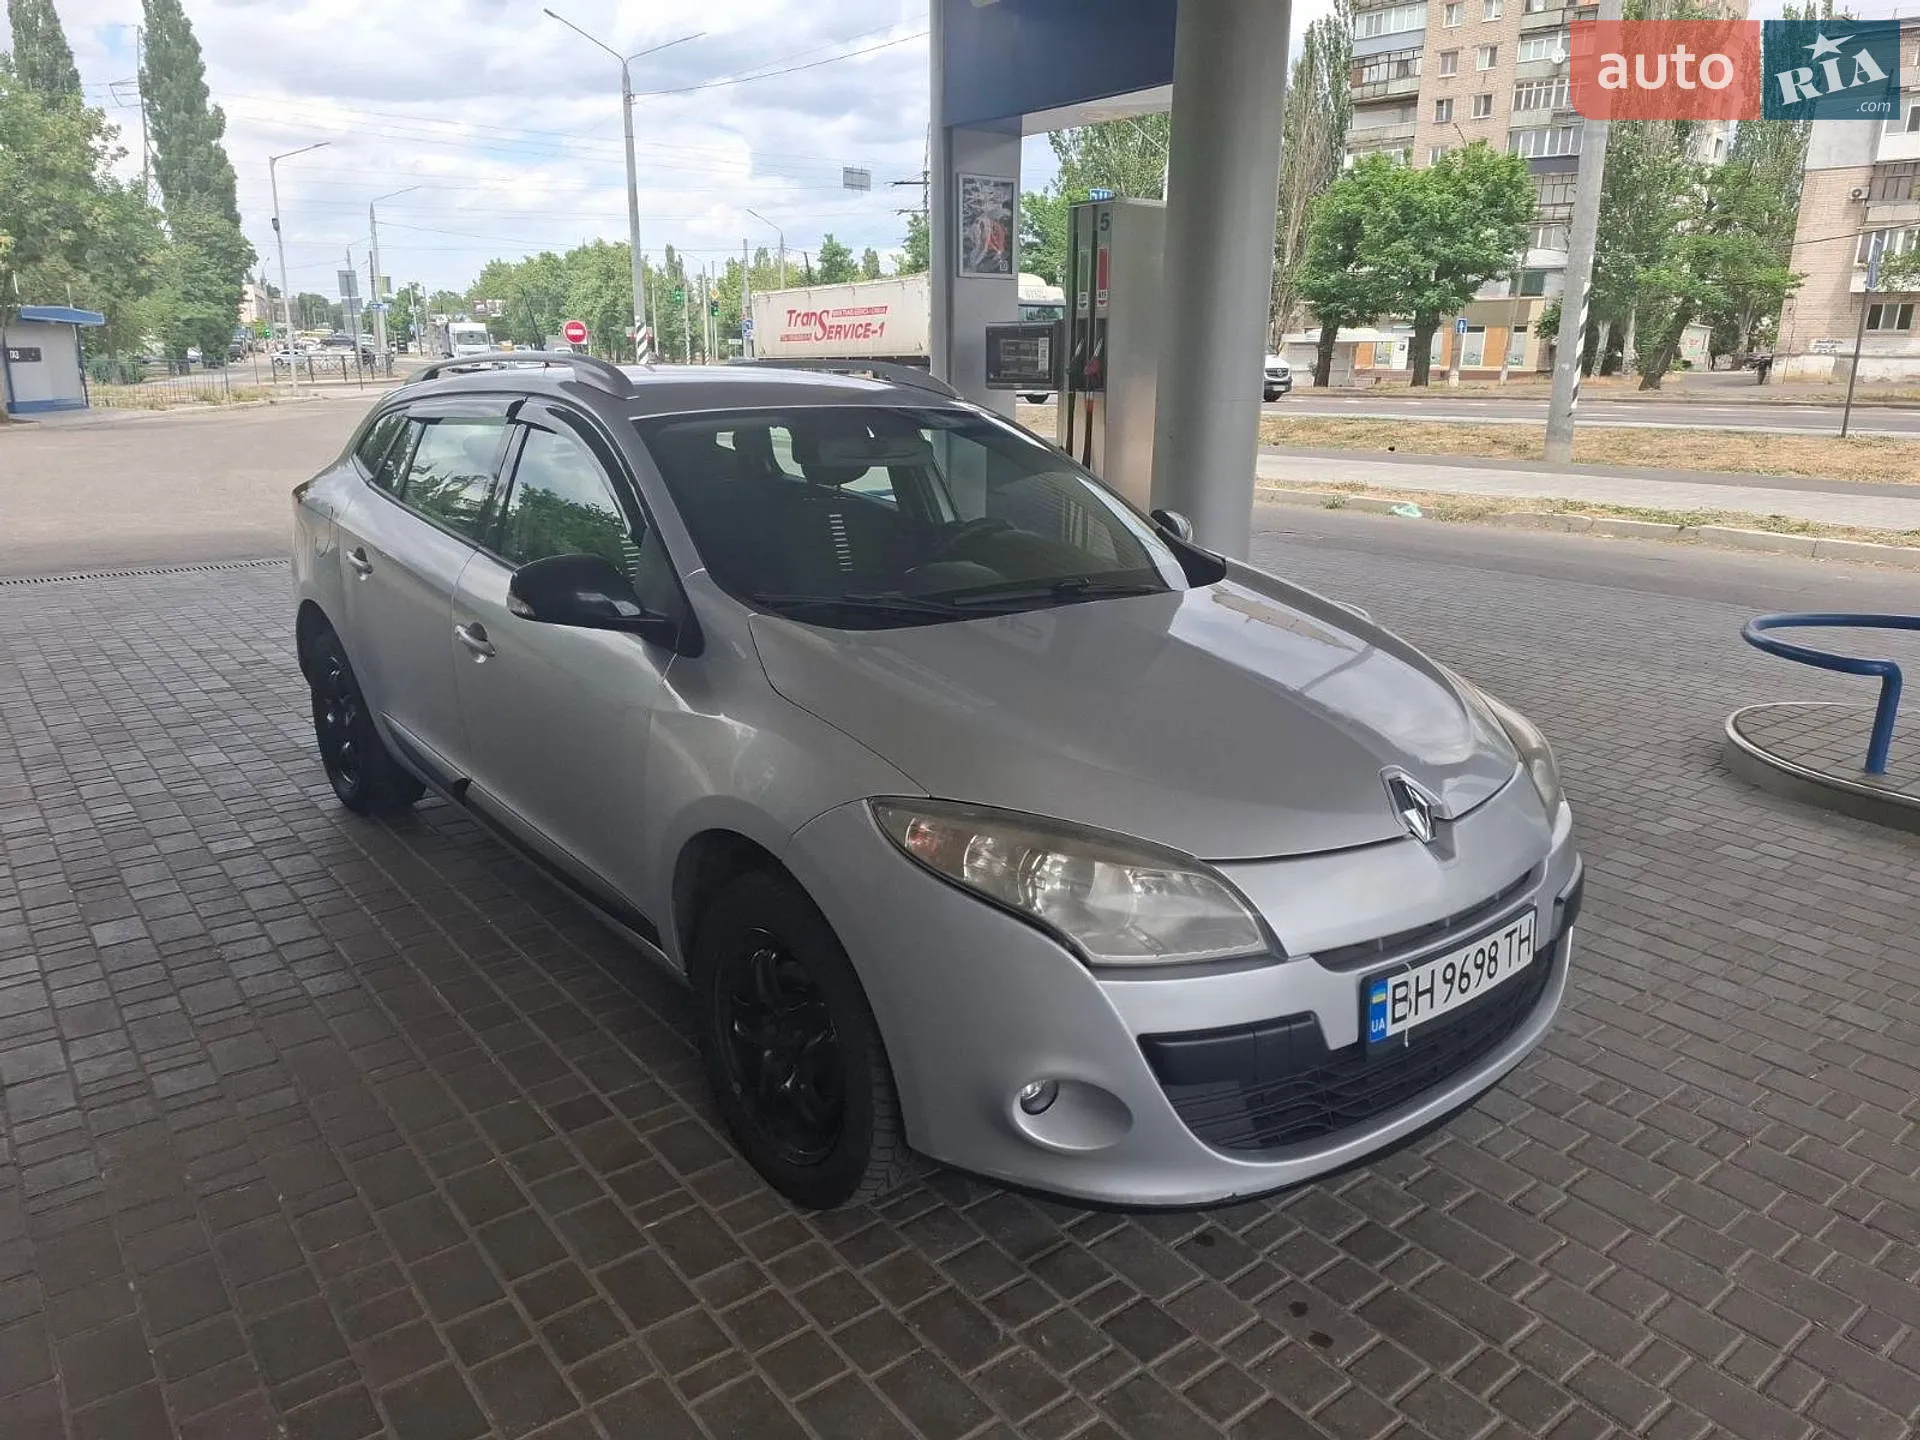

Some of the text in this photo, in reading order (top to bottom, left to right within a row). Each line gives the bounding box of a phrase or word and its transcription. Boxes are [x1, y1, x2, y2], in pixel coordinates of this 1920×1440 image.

[1100, 212, 1110, 231] 5
[1442, 940, 1499, 1004] 9698
[1504, 918, 1533, 968] TH
[1371, 1017, 1386, 1033] UA
